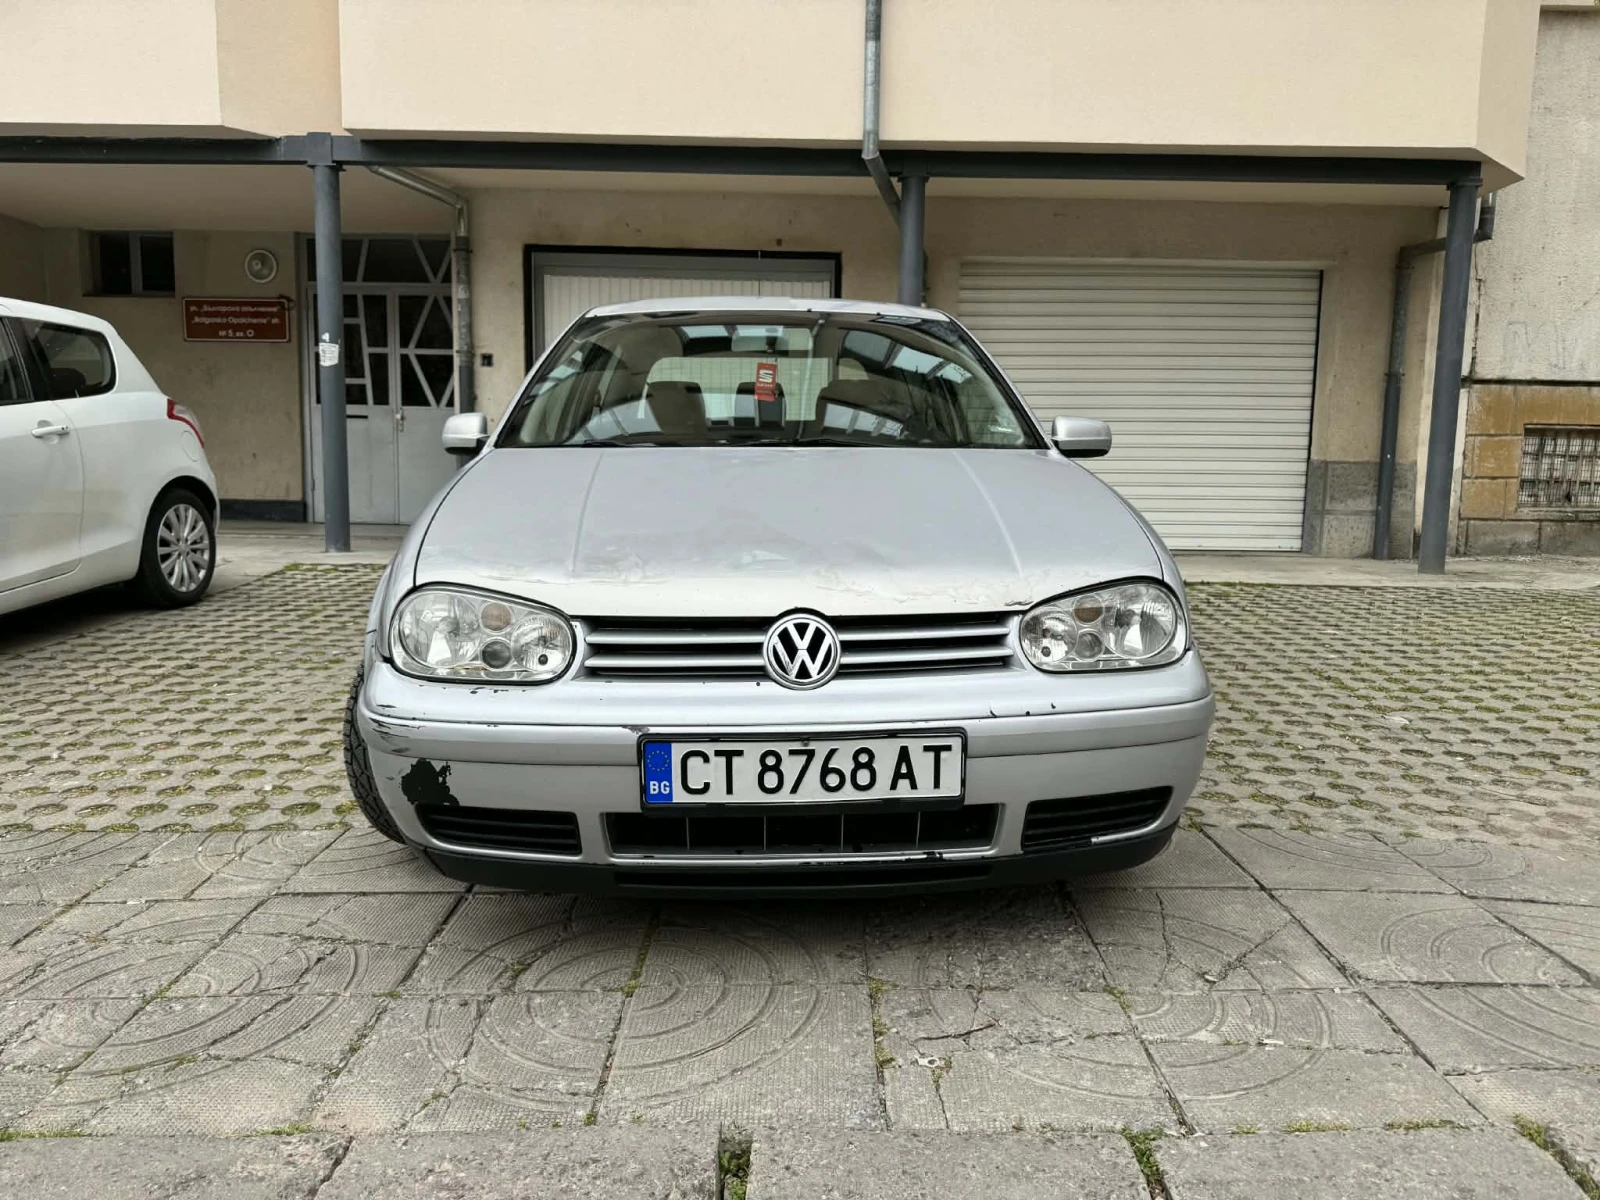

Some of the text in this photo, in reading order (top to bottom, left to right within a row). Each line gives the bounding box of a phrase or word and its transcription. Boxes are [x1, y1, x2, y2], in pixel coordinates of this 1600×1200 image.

[768, 618, 836, 684] VW
[649, 780, 670, 795] BG
[681, 744, 953, 795] CT 8768 AT
